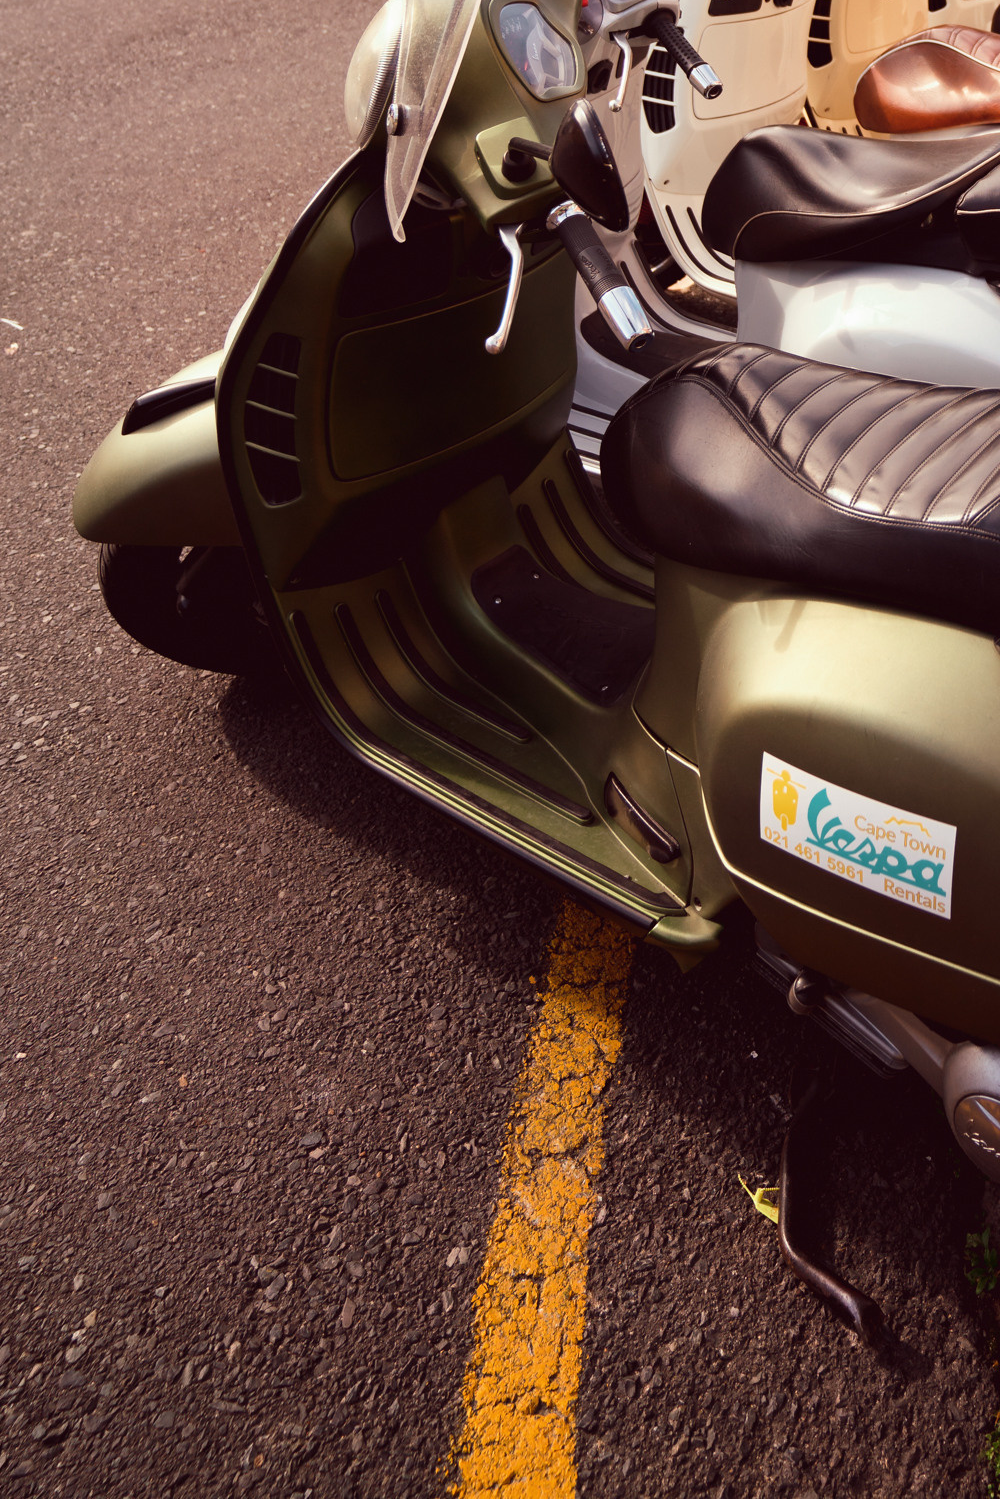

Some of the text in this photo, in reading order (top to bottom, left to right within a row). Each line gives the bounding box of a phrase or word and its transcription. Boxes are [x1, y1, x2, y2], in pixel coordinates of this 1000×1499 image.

[764, 826, 864, 883] 021 461 5961
[805, 788, 946, 897] Vespa
[854, 815, 946, 860] Cape Town
[883, 878, 946, 913] Rentals
